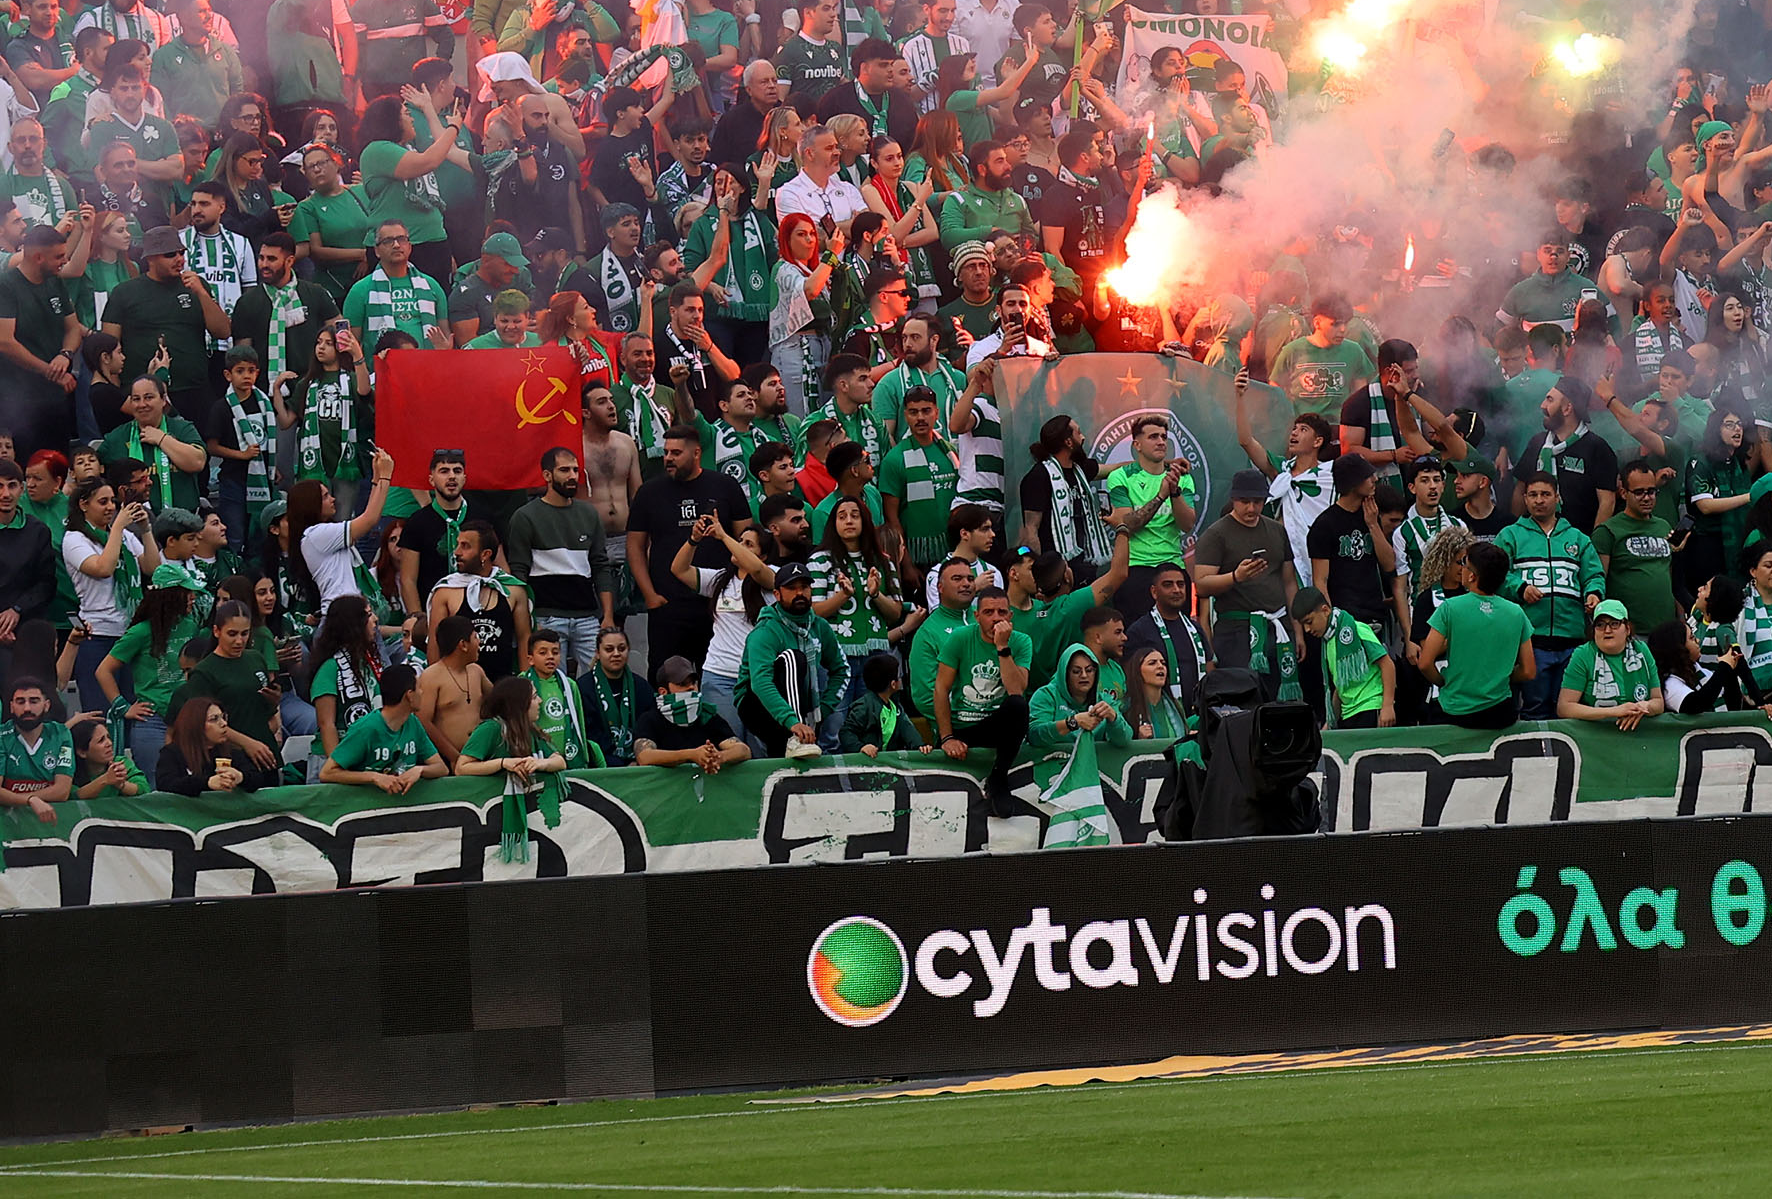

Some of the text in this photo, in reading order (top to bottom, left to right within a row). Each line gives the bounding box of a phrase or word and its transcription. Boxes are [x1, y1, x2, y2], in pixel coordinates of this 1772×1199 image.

[804, 63, 843, 80] novibe
[374, 745, 417, 762] 19 48
[1498, 865, 1684, 956] όλα
[915, 885, 1396, 1018] cytavision
